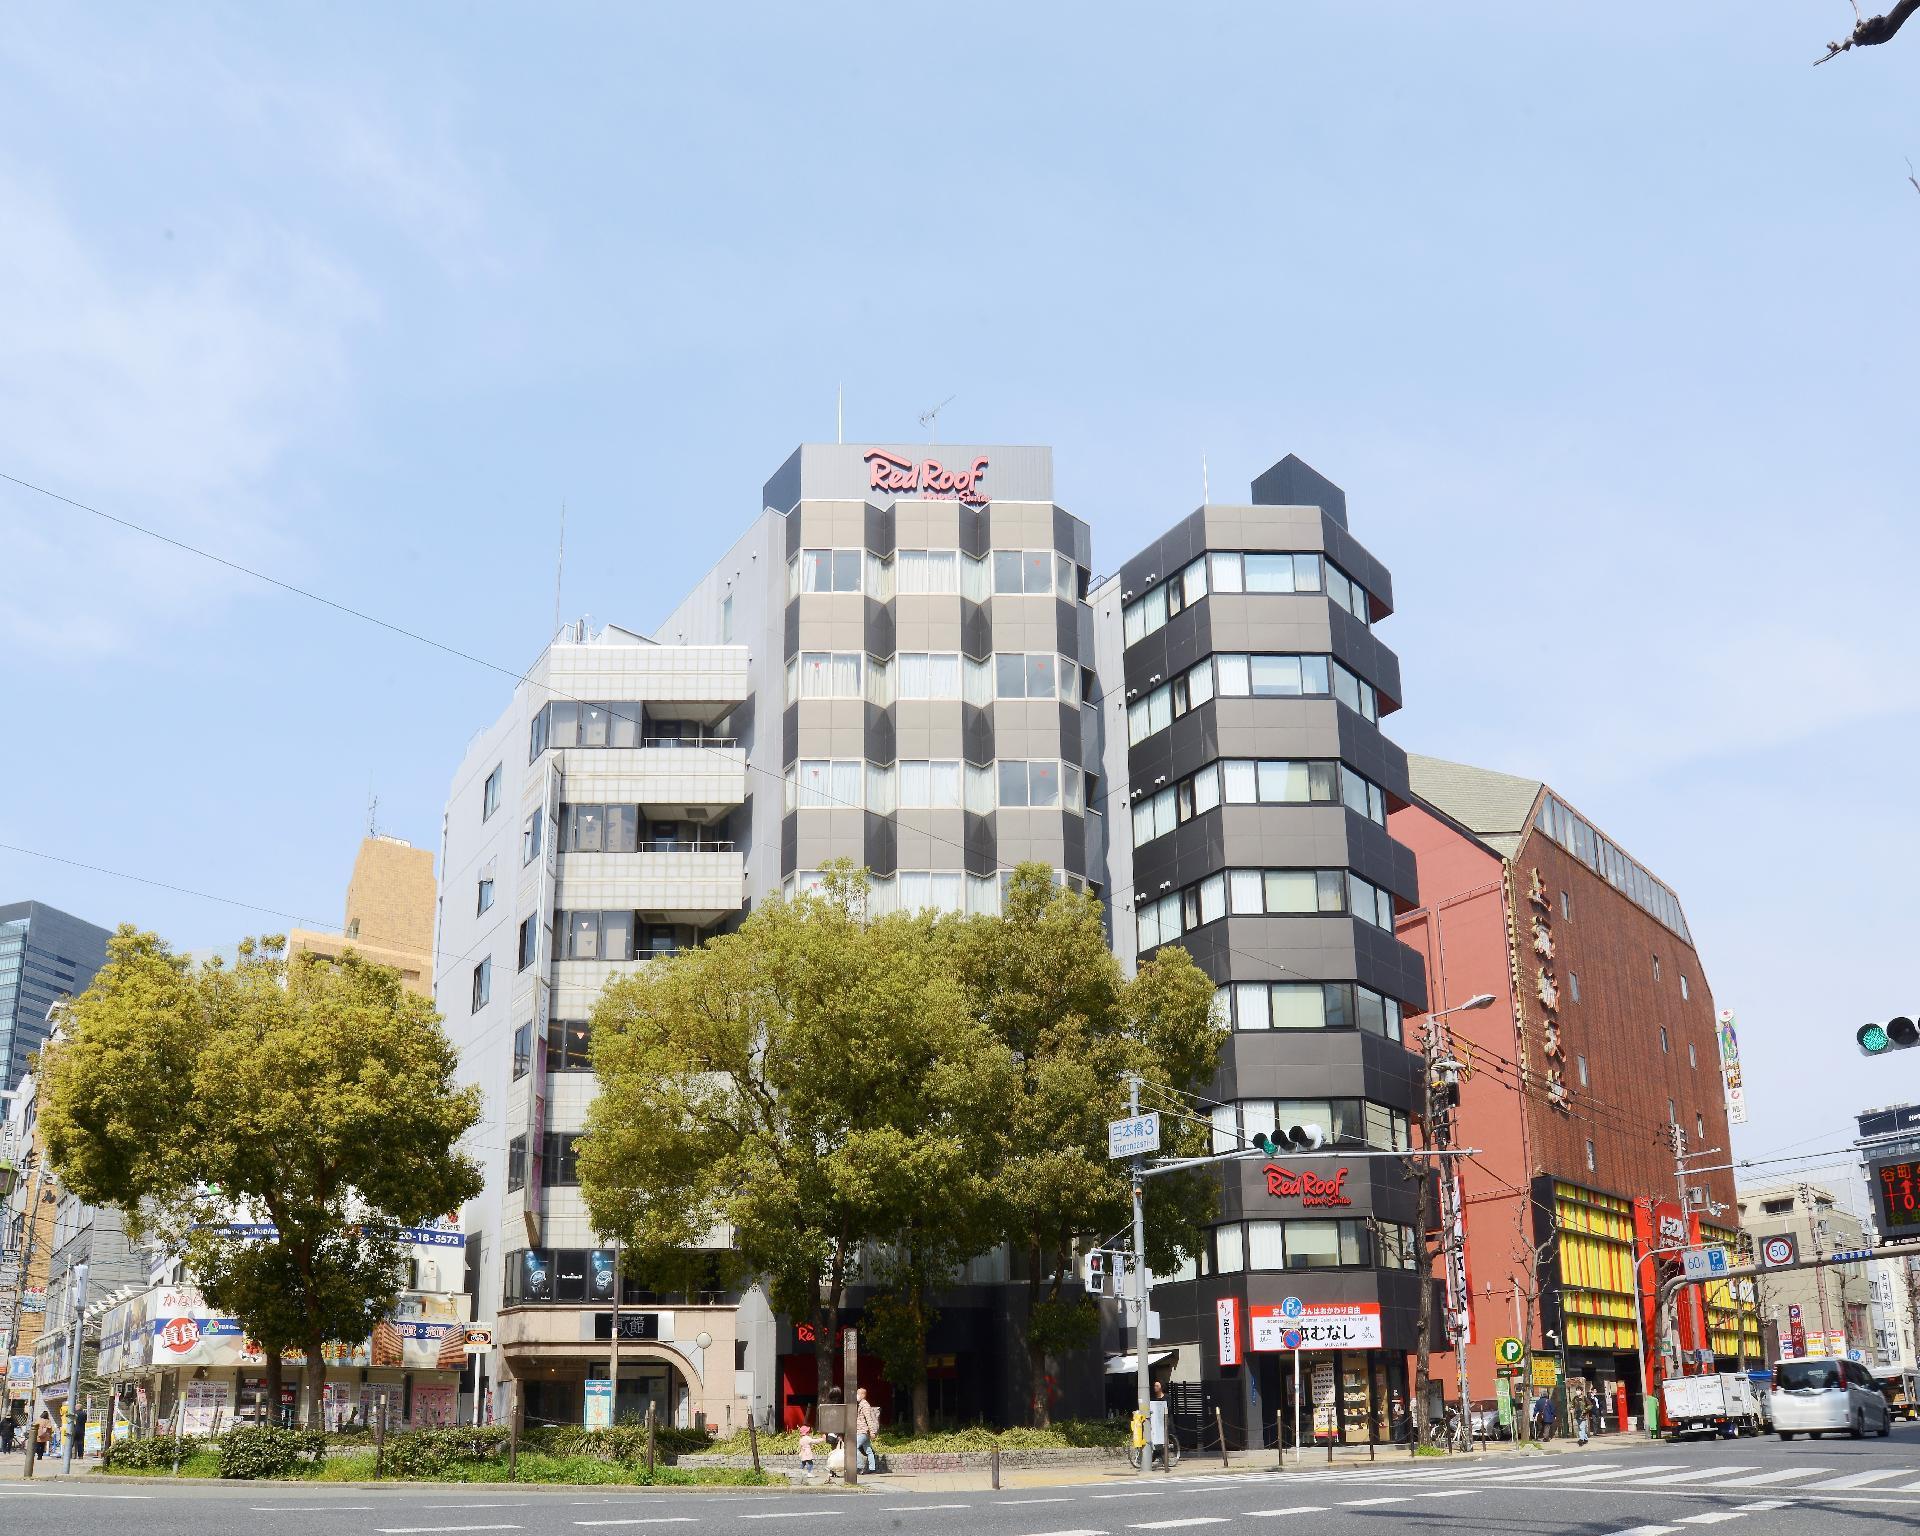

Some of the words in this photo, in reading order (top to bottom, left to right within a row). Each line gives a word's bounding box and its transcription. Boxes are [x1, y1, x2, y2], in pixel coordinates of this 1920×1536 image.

[867, 455, 920, 491] Red
[922, 456, 988, 491] Roof
[1112, 1118, 1154, 1142] 日本橋3
[1881, 1163, 1920, 1183] 谷町
[1265, 1170, 1300, 1197] Red
[1301, 1168, 1348, 1197] Roof
[398, 1231, 460, 1245] 20-18-5573
[1711, 1251, 1721, 1264] P
[1770, 1244, 1787, 1257] 50
[1286, 1301, 1295, 1316] P
[1791, 1307, 1799, 1317] P
[160, 1321, 200, 1349] 賃貸
[1506, 1342, 1519, 1360] P
